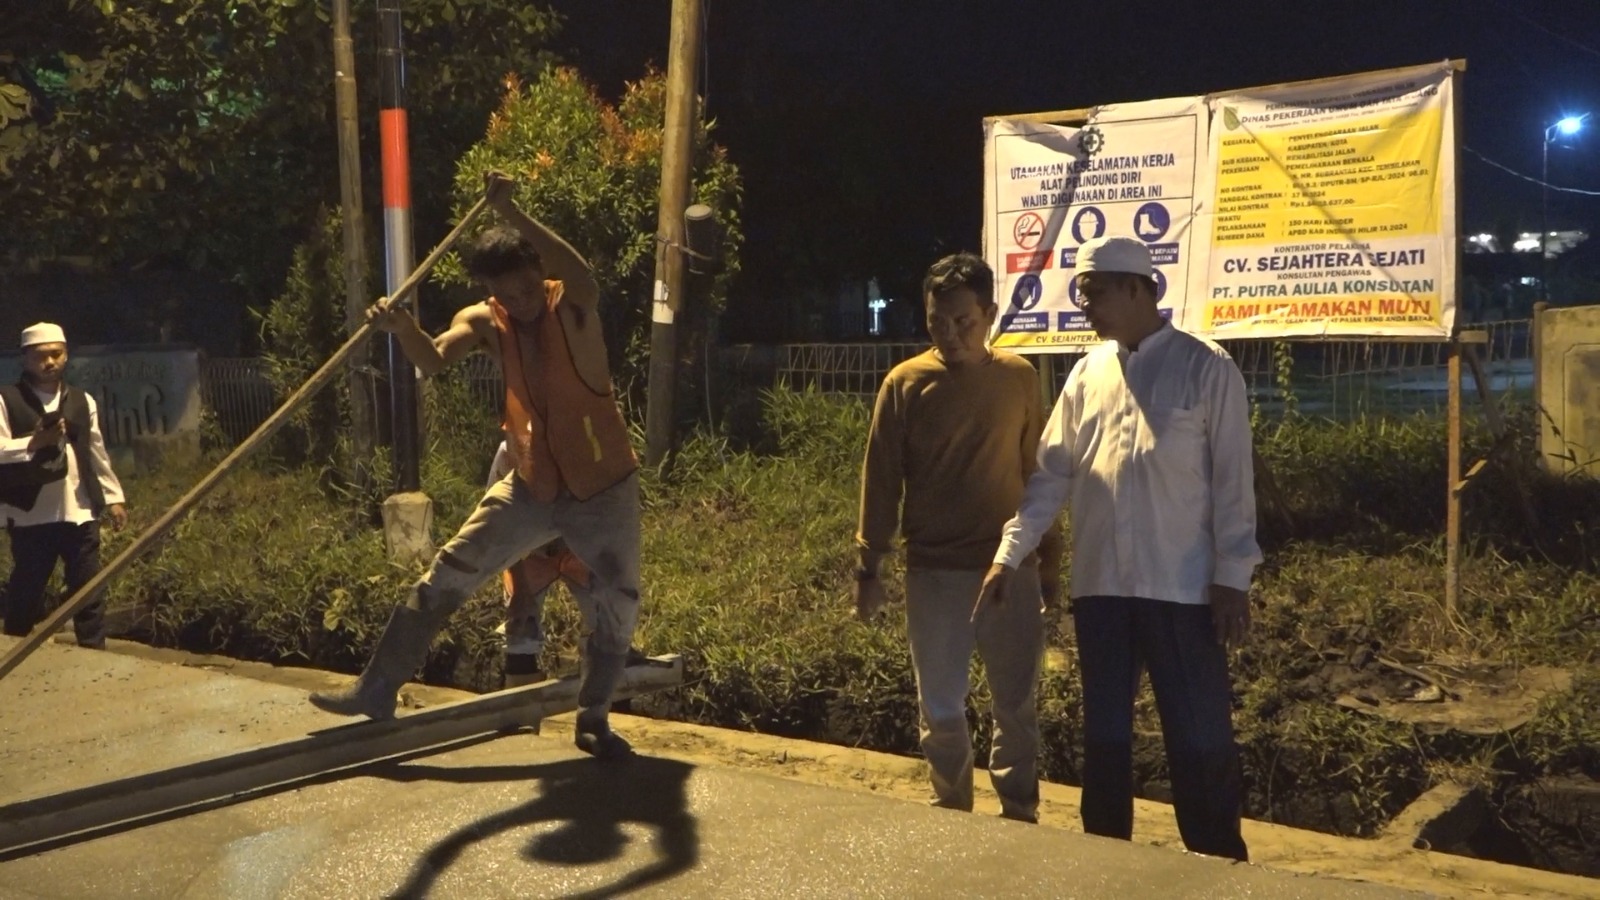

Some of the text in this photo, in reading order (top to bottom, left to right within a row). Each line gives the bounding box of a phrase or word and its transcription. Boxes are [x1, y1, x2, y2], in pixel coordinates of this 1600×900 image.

[1241, 114, 1271, 124] DINAS
[1272, 107, 1325, 121] PEKERJAAN
[1222, 138, 1256, 147] KEGIATAN
[1358, 124, 1379, 133] JALAN
[1236, 156, 1270, 164] KEGIATAN
[1286, 151, 1334, 161] REHABILITASI
[1335, 148, 1356, 157] JALAN
[1010, 153, 1175, 180] UTAMAKAN KESELAMATAN KERJA
[1221, 166, 1260, 175] PEKERJAAN
[1342, 156, 1375, 165] BERKALA
[1040, 171, 1141, 191] ALAT PELINDUNG DIRI
[1231, 184, 1262, 193] KONTRAK
[1021, 184, 1163, 208] WAJIB DIGUNAKAN DI AREA INI
[1219, 195, 1250, 203] TANGGAL
[1250, 192, 1283, 201] KONTRAK
[1237, 203, 1269, 212] KONTRAK
[1216, 223, 1267, 232] PELAKSANAAN
[1217, 215, 1242, 223] WAKTU
[1216, 234, 1244, 242] SUMBER
[1245, 232, 1266, 240] DANA
[1389, 223, 1408, 231] 2024
[1274, 243, 1327, 253] KONTRAKTOR
[1223, 249, 1425, 273] CV. SEJAHTERA SEJATI
[1277, 269, 1371, 280] KONSULTAN PENGAWAS
[1213, 287, 1233, 298] PT.
[1237, 284, 1288, 298] PUTRA
[1291, 281, 1338, 296] AULIA
[1212, 303, 1260, 320] KAMI
[1051, 335, 1098, 343] SEJAHTERA
